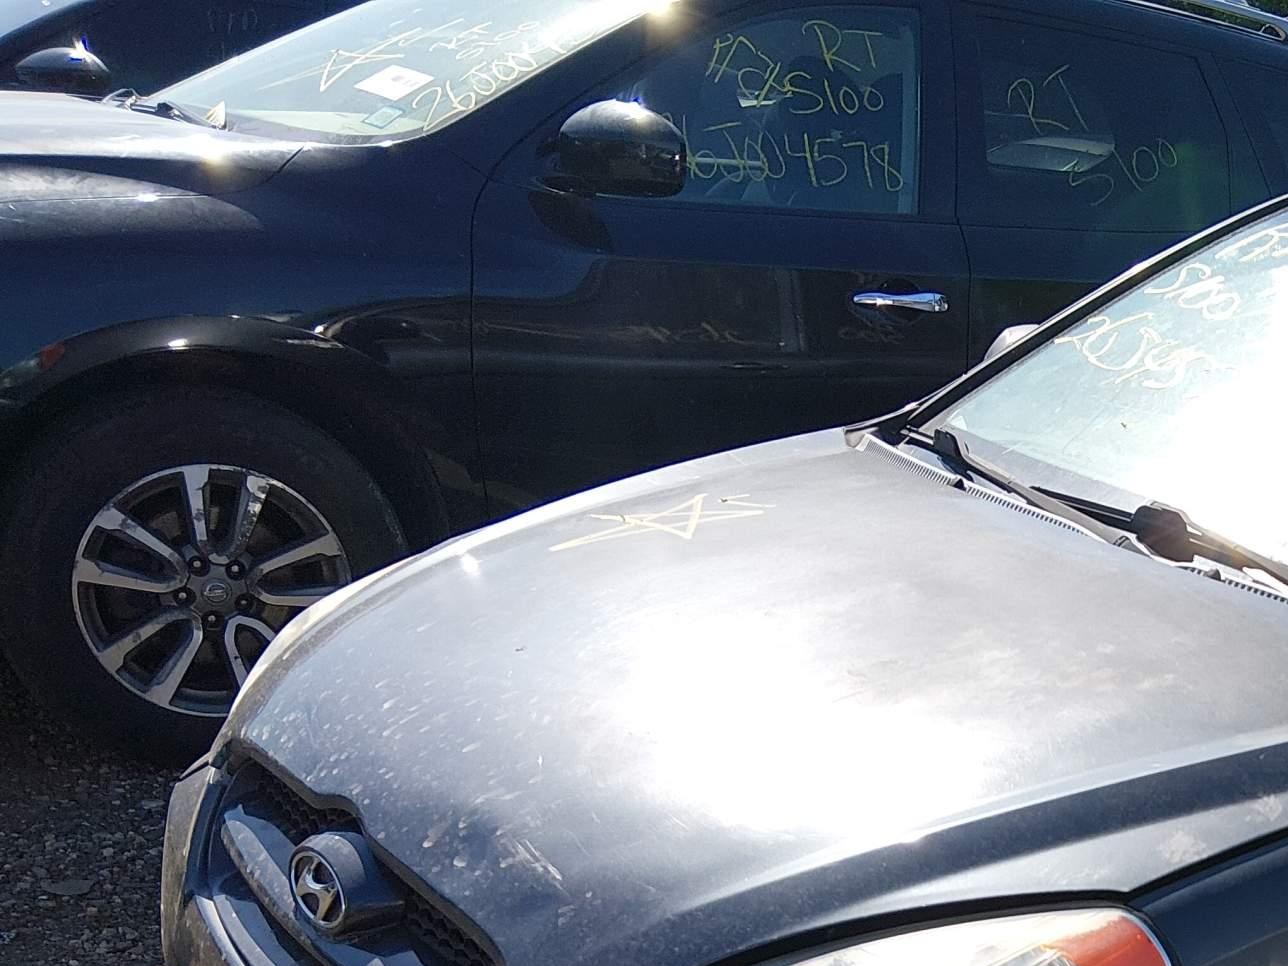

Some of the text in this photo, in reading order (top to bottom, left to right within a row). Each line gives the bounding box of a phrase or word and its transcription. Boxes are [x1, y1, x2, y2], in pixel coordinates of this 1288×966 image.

[802, 19, 884, 73] RT
[784, 71, 885, 115] 5100
[1006, 64, 1089, 135] RT
[663, 112, 904, 192] 6J004578
